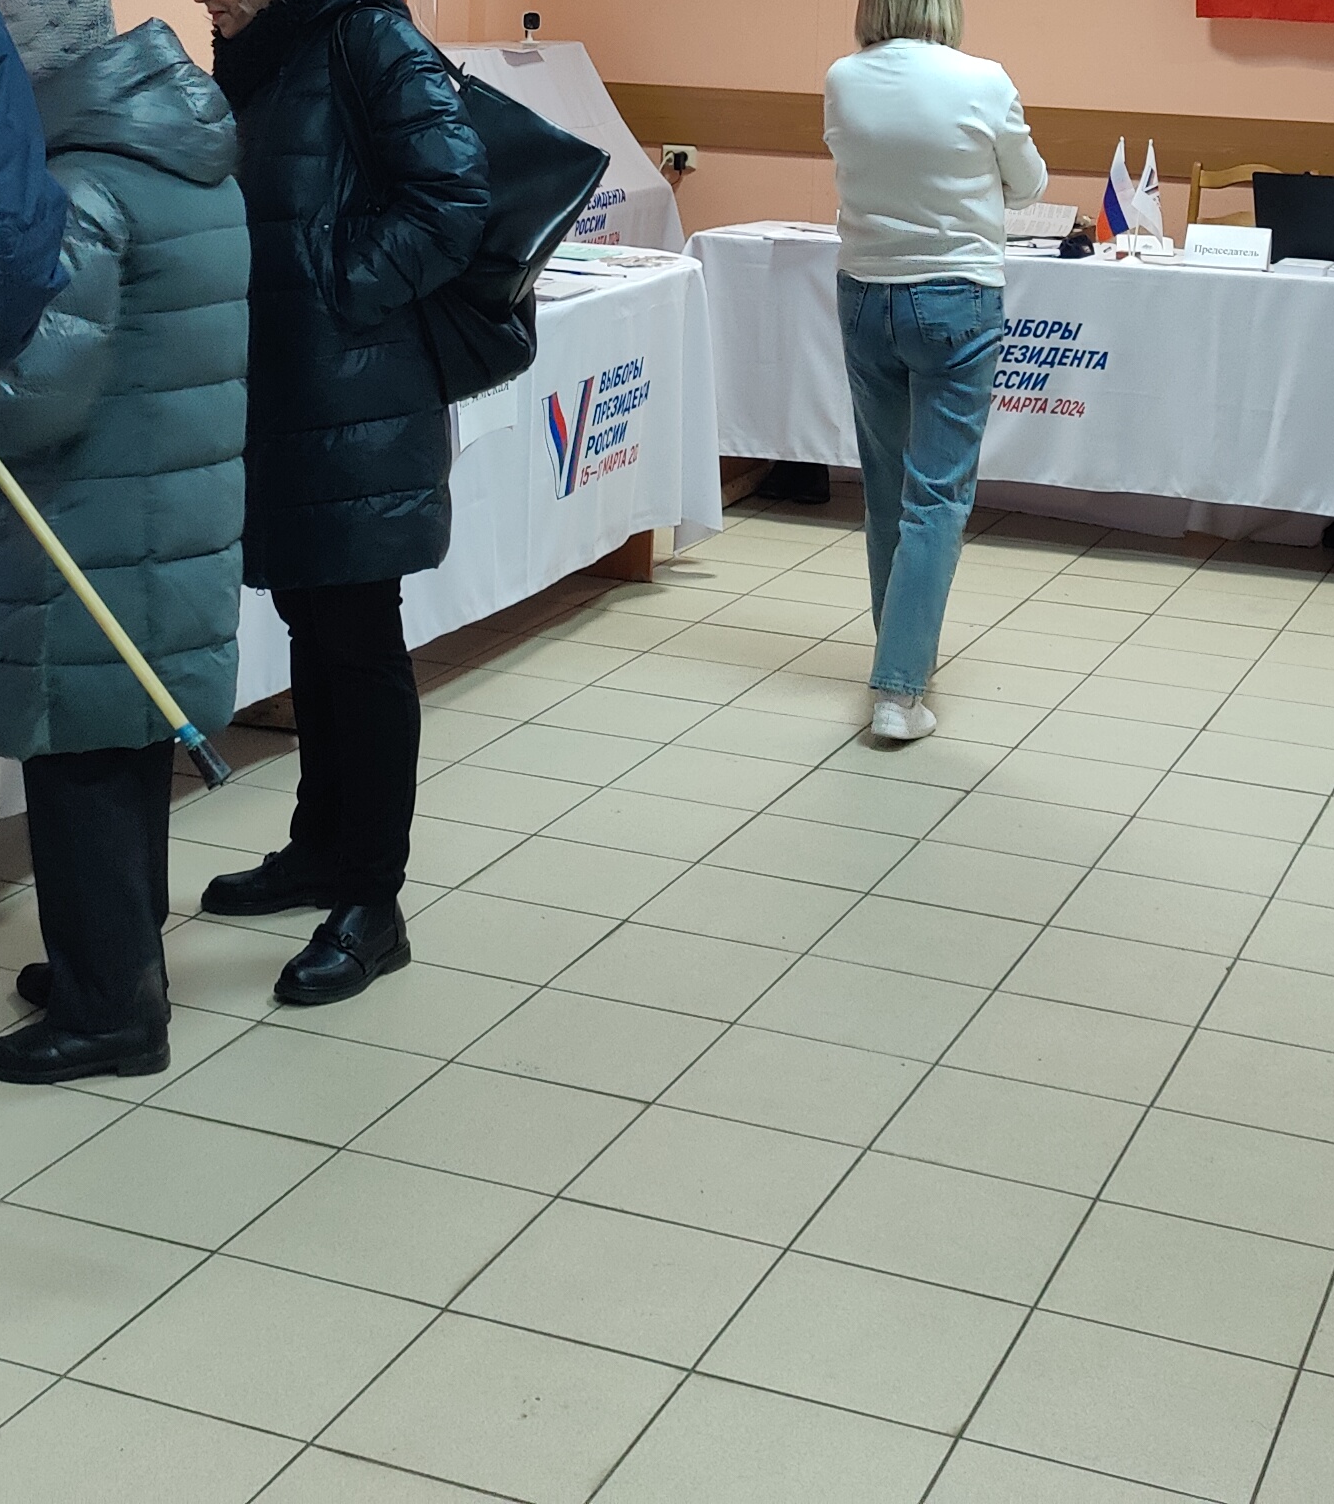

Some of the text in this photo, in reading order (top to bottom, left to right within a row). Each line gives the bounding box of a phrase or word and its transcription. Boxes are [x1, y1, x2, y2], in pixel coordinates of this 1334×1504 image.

[587, 188, 626, 210] ЕЗИДЕНТА
[575, 213, 607, 237] РОССИИ
[1194, 244, 1260, 257] Председатель
[1003, 318, 1083, 341] ЫБОРЫ
[999, 345, 1108, 370] ЕЗИДЕНТА
[599, 356, 644, 394] ВЫБОРЫ
[993, 370, 1050, 391] ССИИ
[997, 395, 1048, 414] МАРТА
[1050, 398, 1085, 417] 2024
[585, 420, 628, 458] РОССИИ
